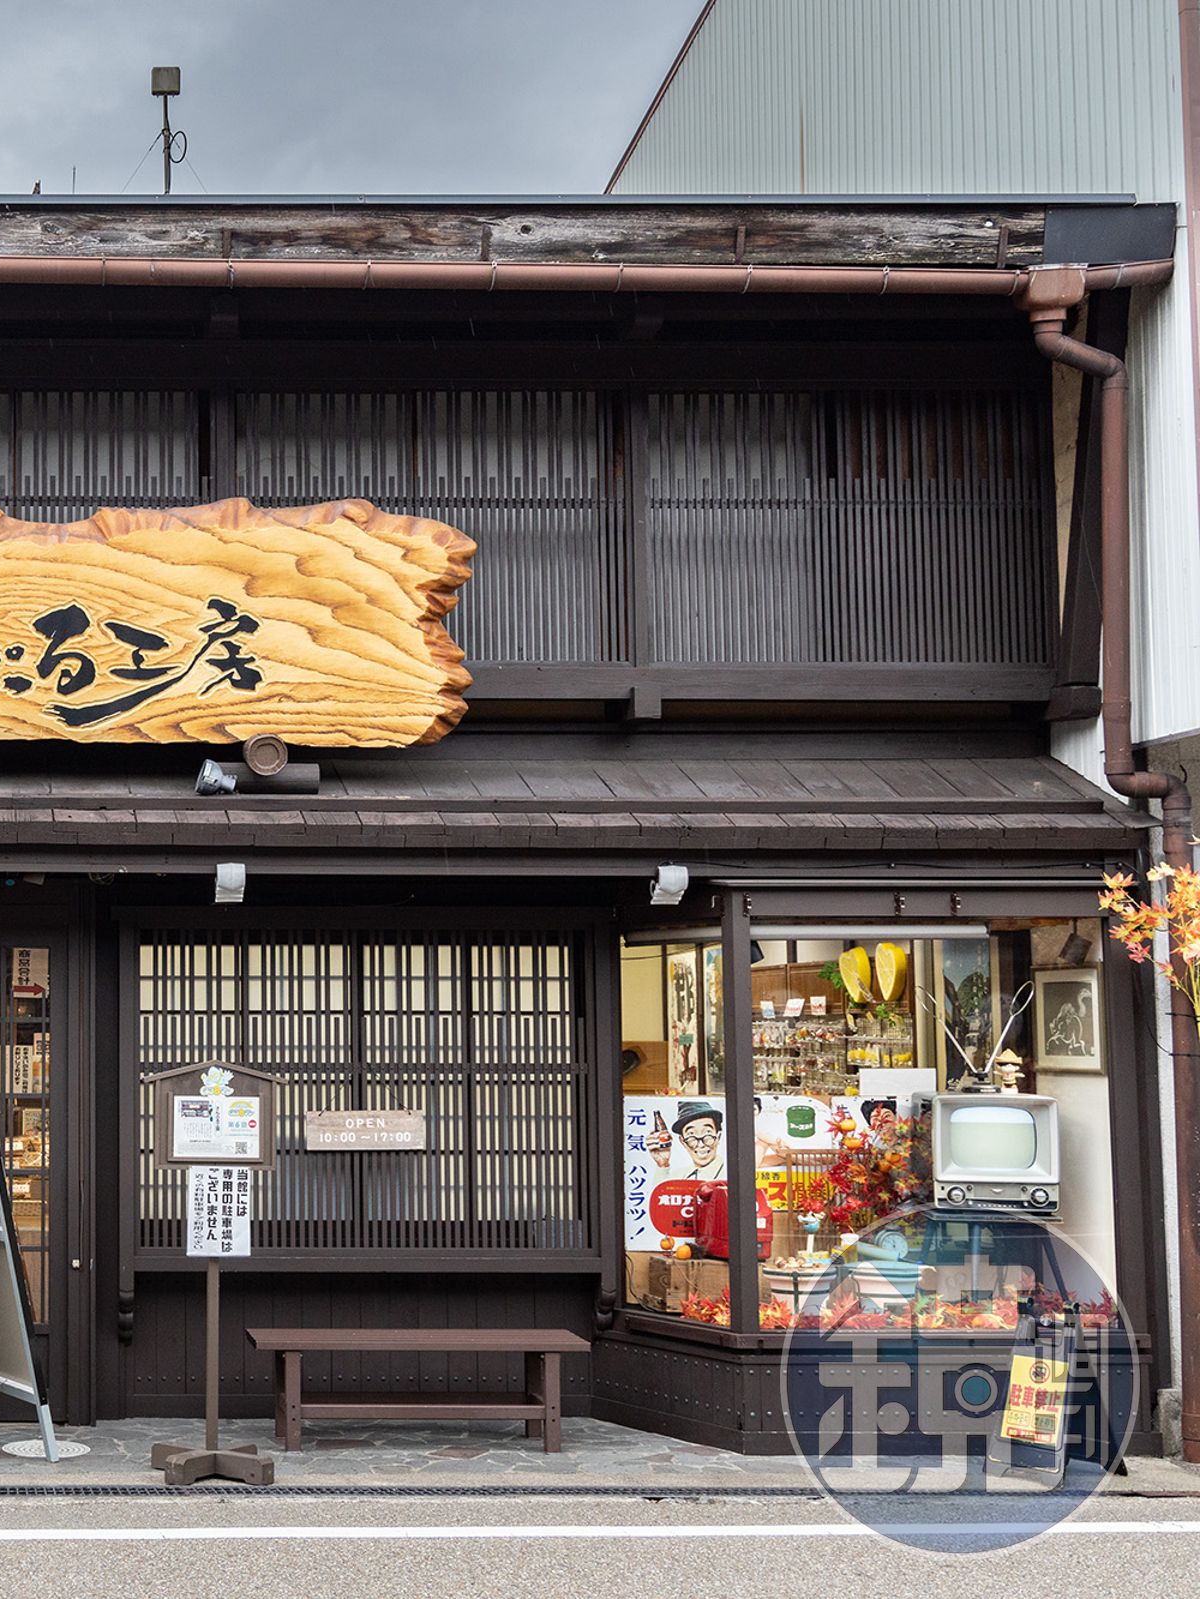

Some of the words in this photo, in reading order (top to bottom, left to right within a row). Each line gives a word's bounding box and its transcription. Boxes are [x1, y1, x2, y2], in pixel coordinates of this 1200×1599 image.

[345, 1118, 385, 1129] OPEN
[237, 1169, 248, 1217] 当館には
[627, 1108, 648, 1240] 元気ハツラツ!
[206, 1168, 219, 1241] ございません
[221, 1169, 233, 1252] 専用の駐車場は
[1009, 1383, 1061, 1413] 駐車禁止
